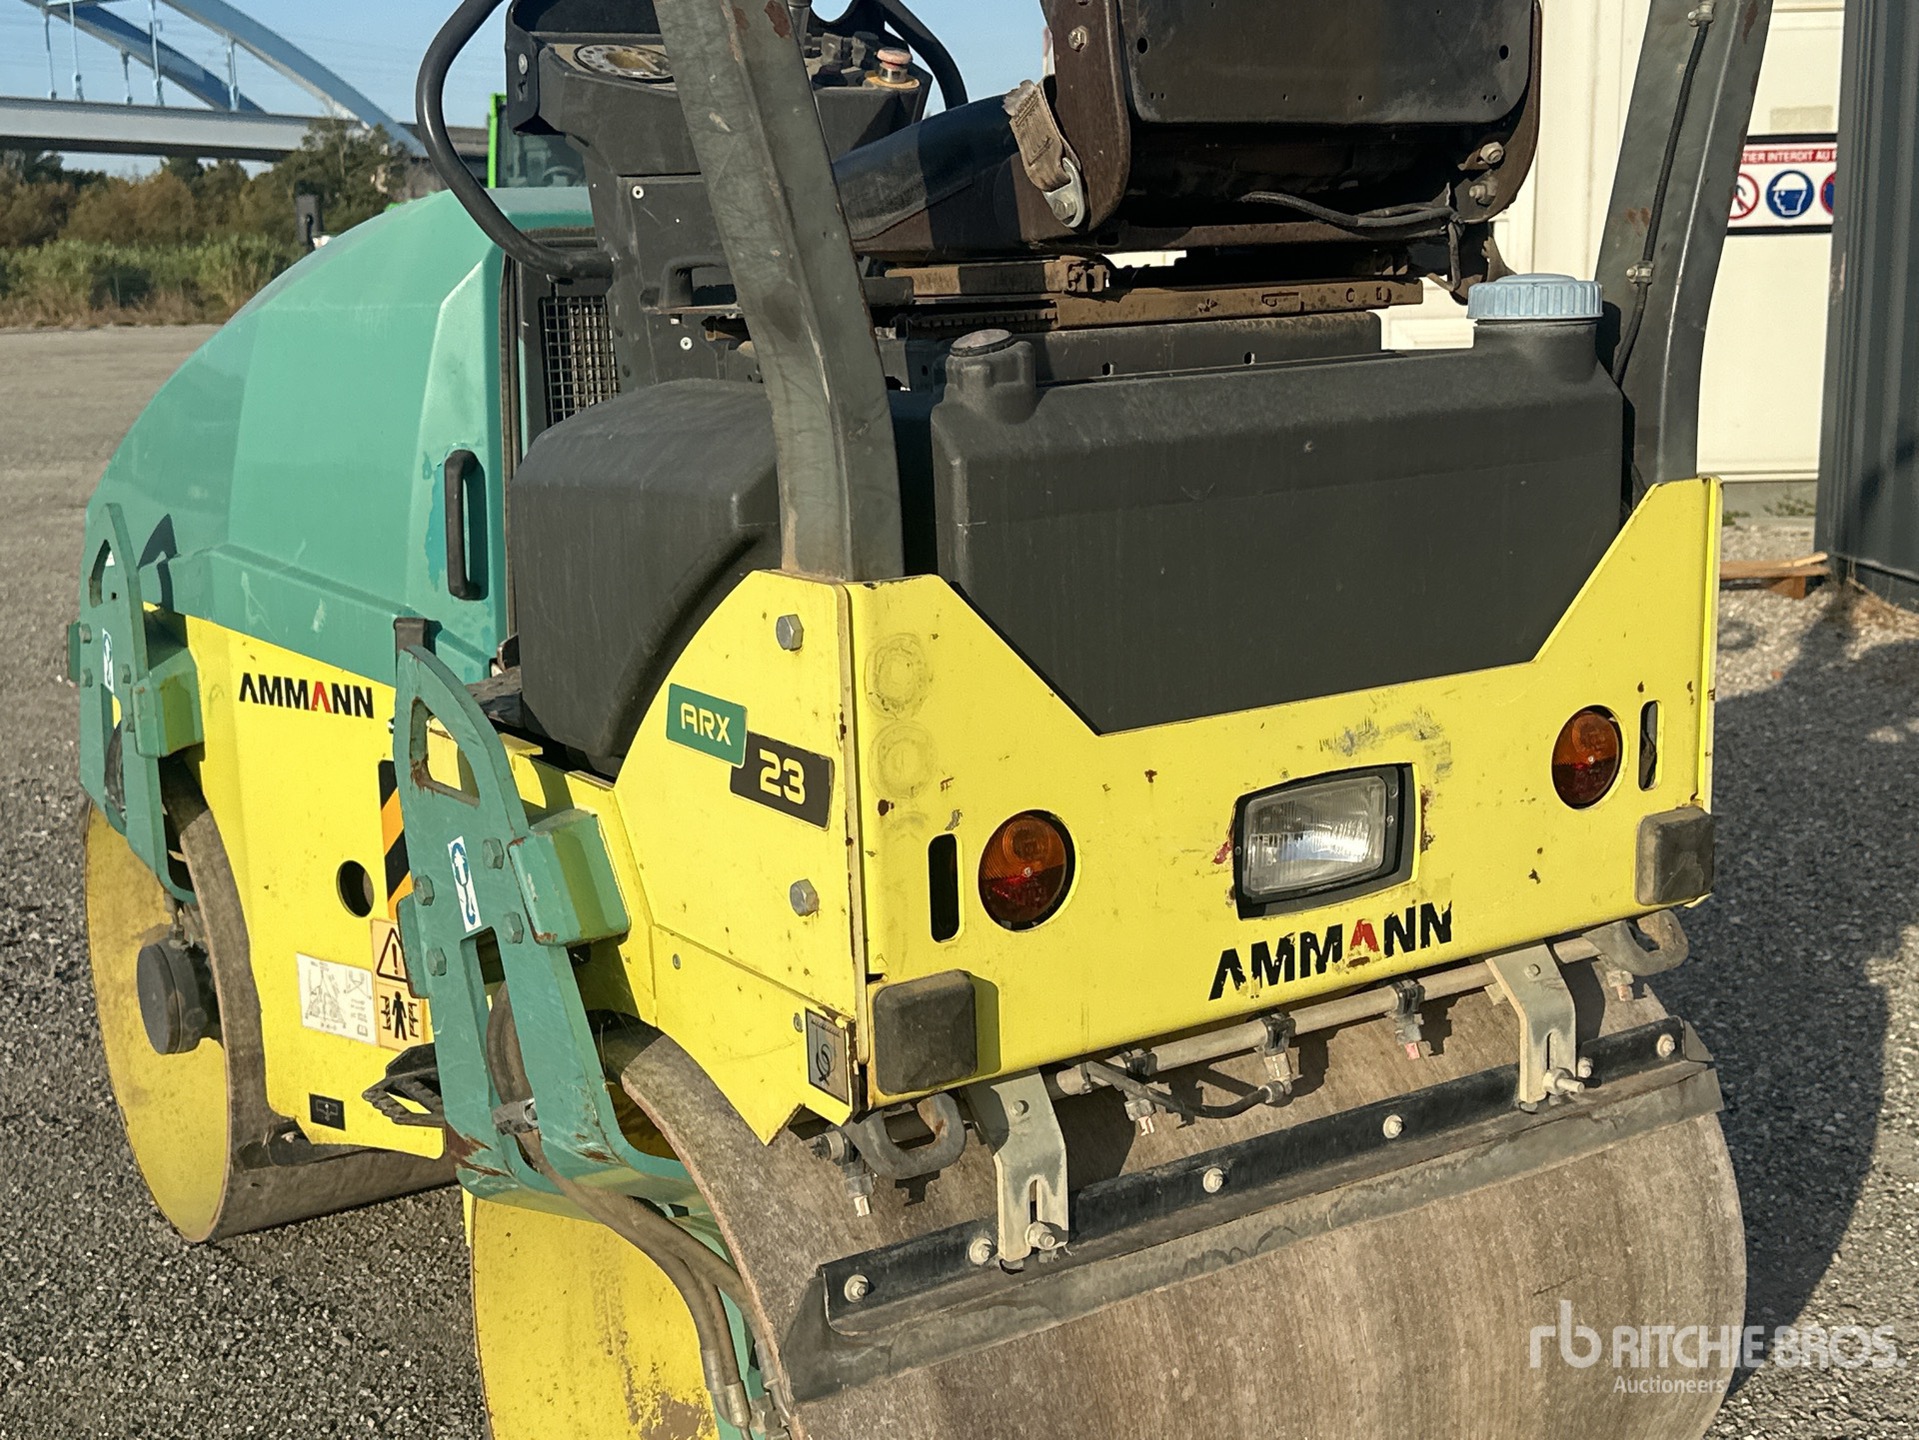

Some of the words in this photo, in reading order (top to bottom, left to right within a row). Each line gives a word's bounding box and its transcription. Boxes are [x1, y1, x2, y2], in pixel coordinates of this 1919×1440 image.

[1743, 151, 1765, 162] TIER
[1767, 150, 1813, 161] INTERDIT
[1814, 149, 1830, 160] AU
[239, 672, 374, 719] AMMANN
[680, 702, 732, 746] ARX
[759, 748, 806, 805] 23
[1208, 900, 1453, 1001] AMMANN
